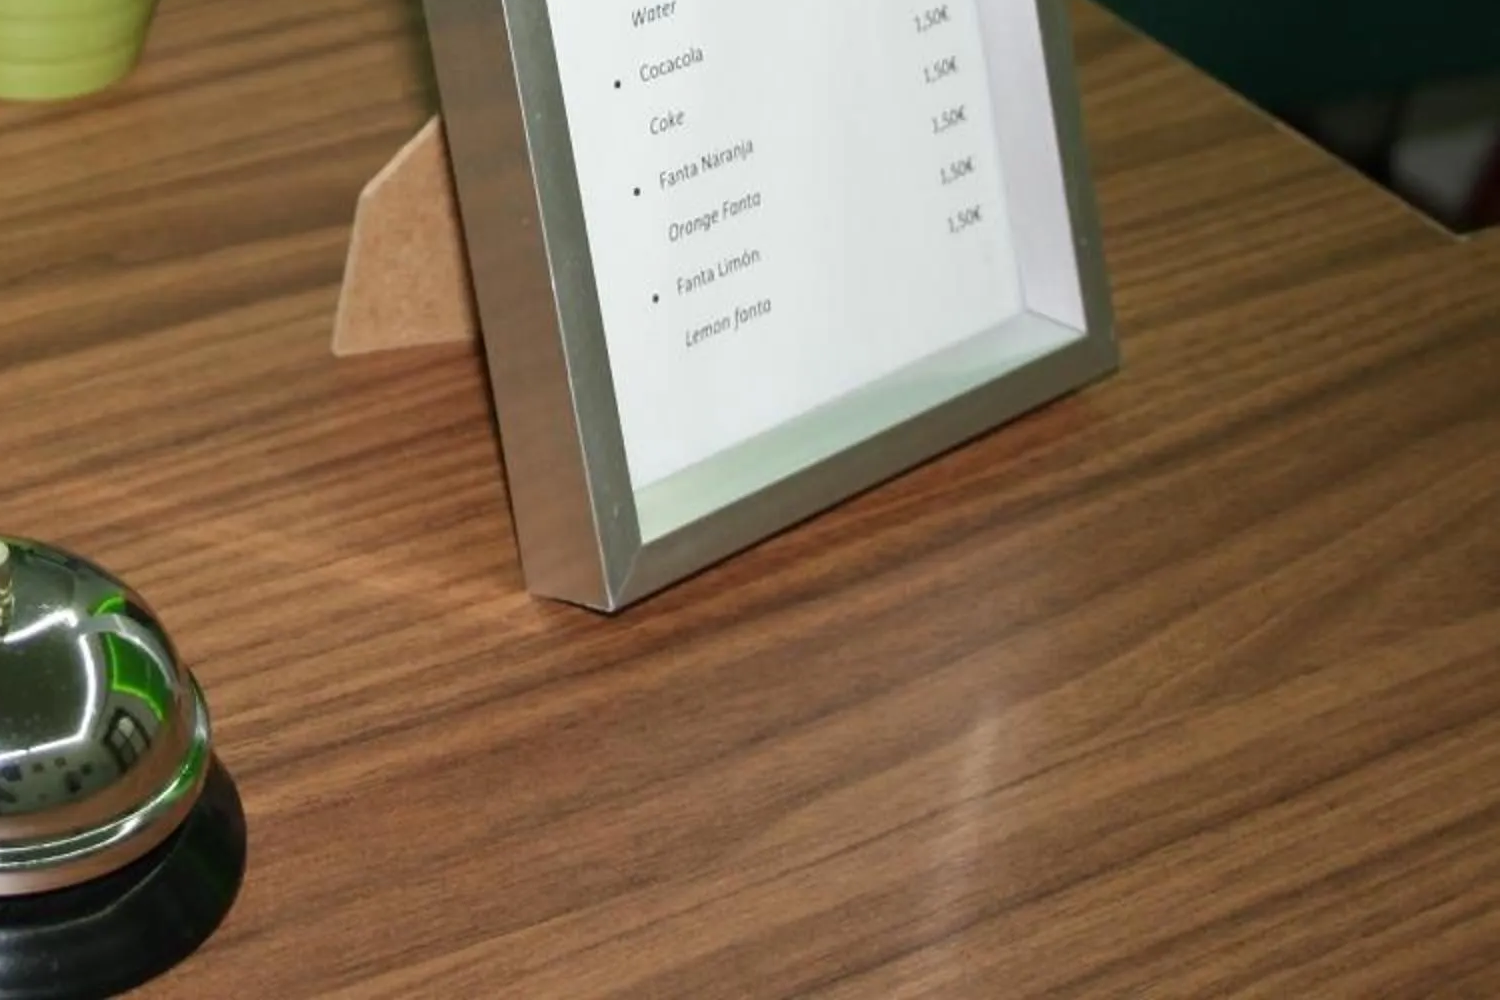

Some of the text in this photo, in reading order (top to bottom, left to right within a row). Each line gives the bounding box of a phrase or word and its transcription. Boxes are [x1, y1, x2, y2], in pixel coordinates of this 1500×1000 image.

[631, 0, 677, 29] Water
[913, 4, 951, 34] 1,50€
[639, 47, 704, 82] Cocacola
[924, 55, 959, 84] 1,50€
[649, 110, 685, 135] Coke
[931, 104, 967, 135] 1,50€
[659, 139, 754, 190] Fanta Naranja
[940, 156, 976, 185] 1,50€
[668, 192, 761, 242] Orange Fanta
[947, 204, 982, 234] 1,50€
[676, 248, 762, 296] Fanta Limón
[685, 298, 772, 348] Lemon fanta
